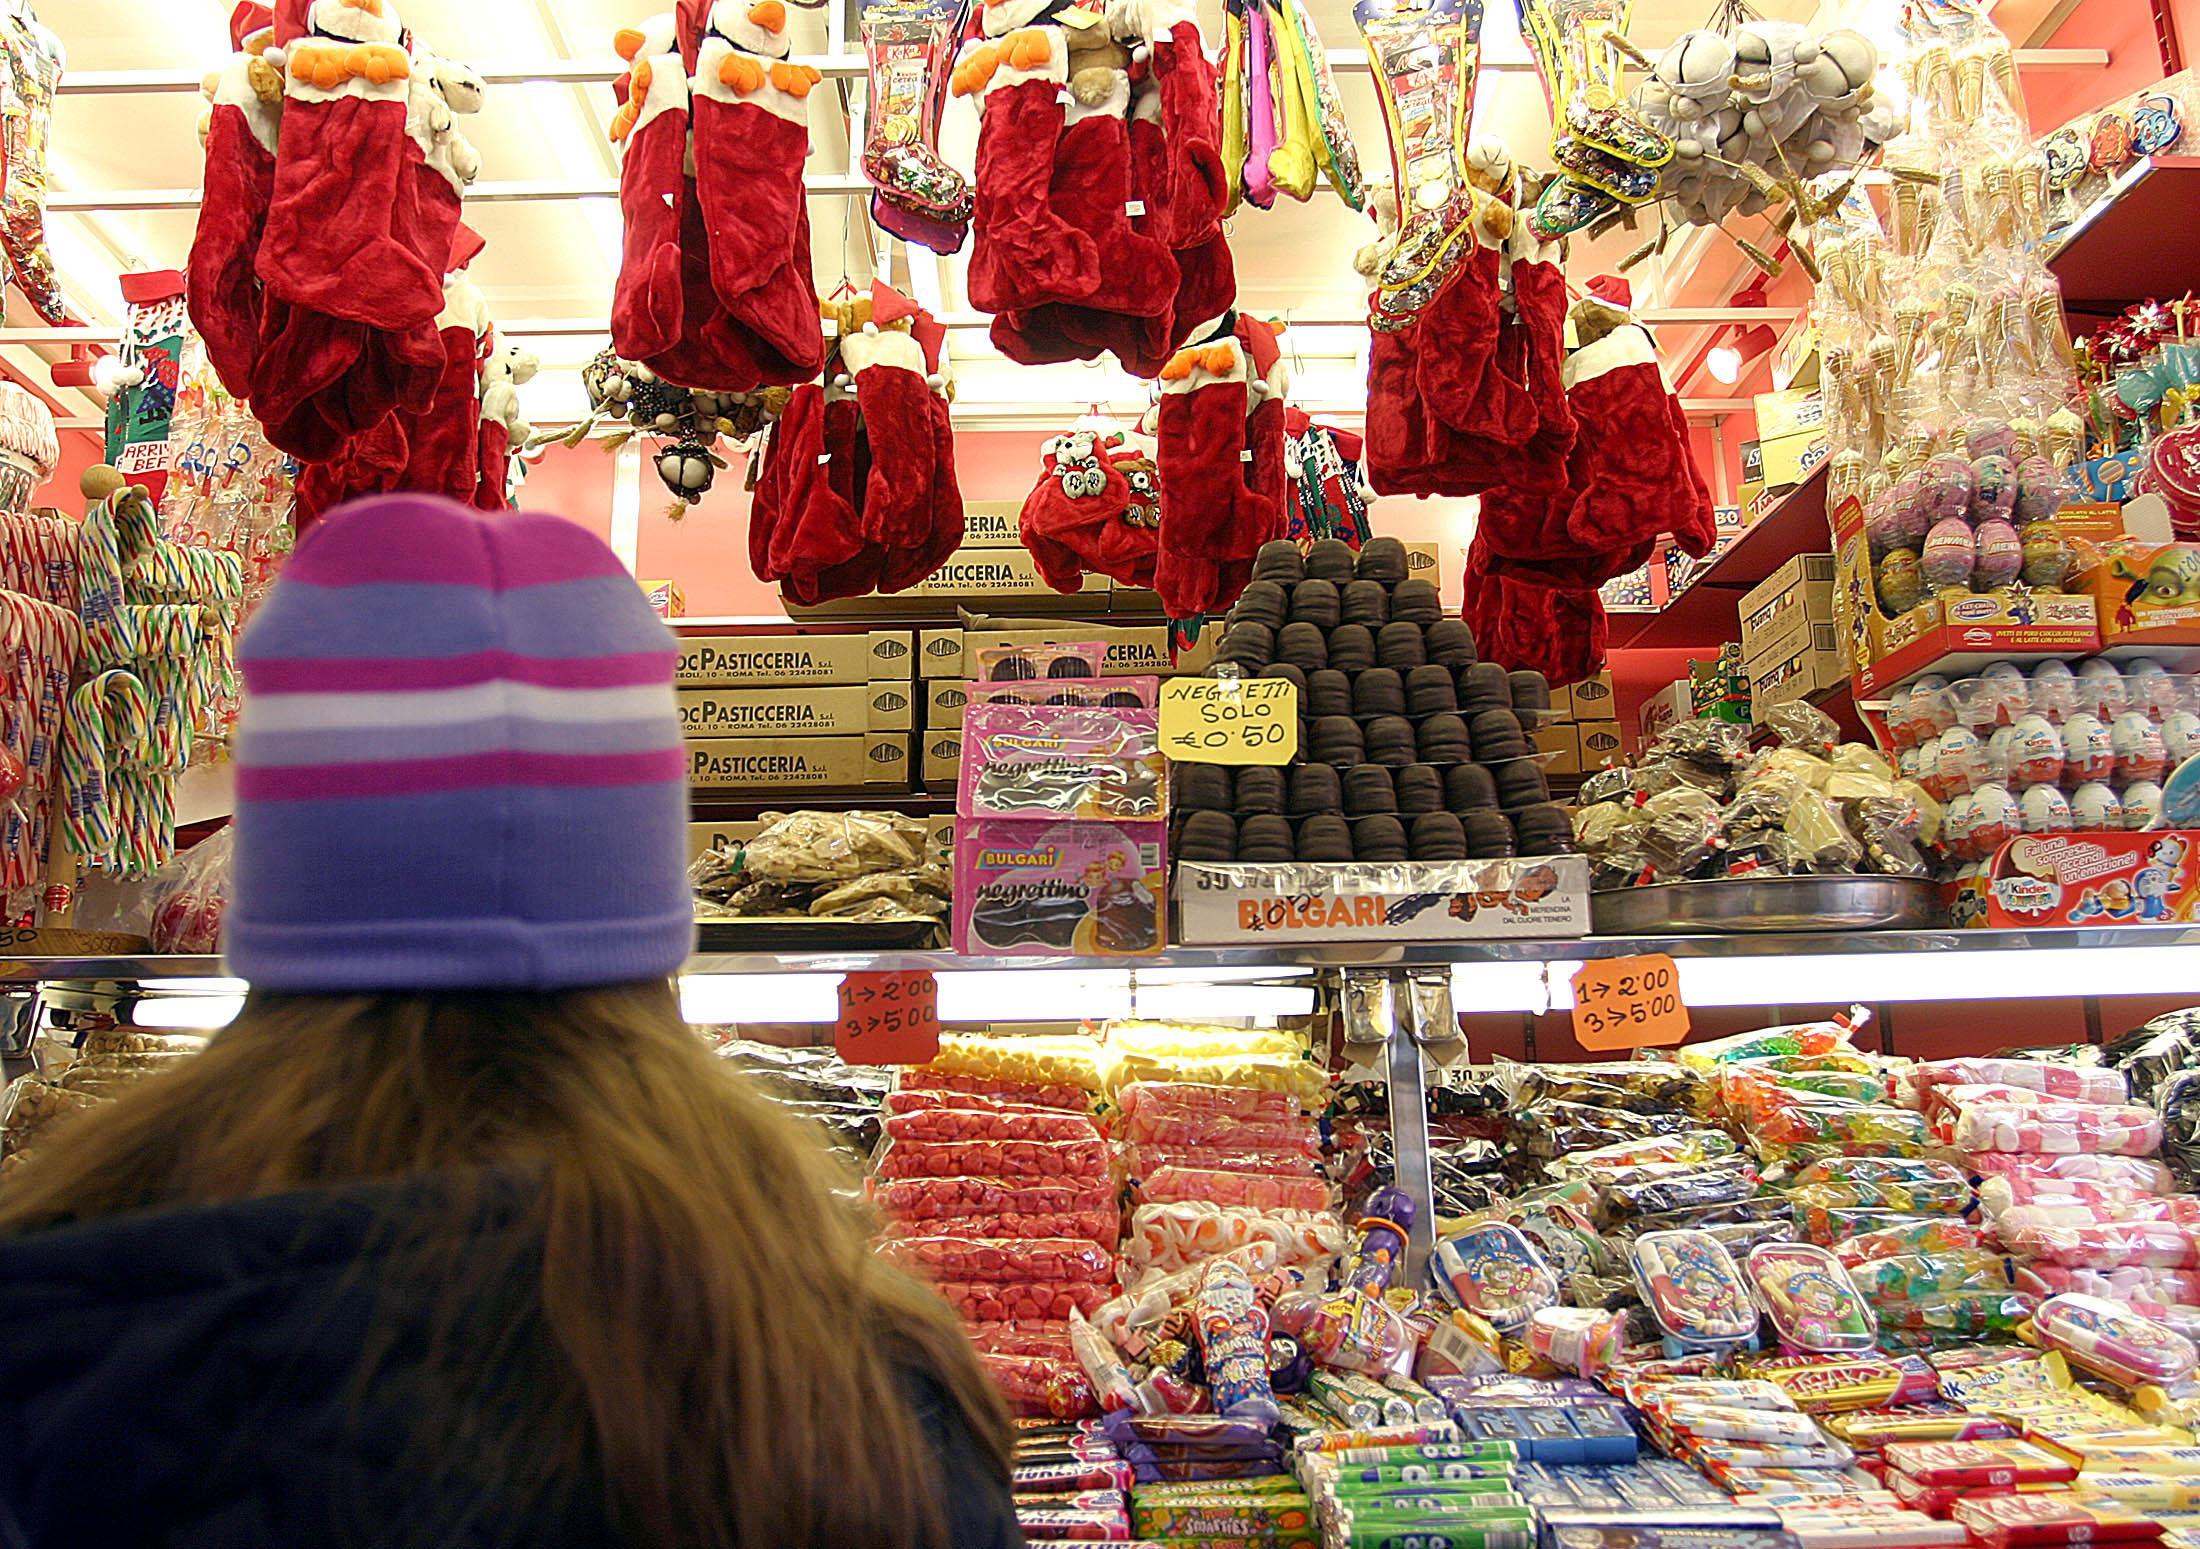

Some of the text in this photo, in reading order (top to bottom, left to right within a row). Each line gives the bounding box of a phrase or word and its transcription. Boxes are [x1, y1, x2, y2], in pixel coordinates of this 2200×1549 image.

[726, 670, 754, 678] ROMA
[1200, 703, 1271, 723] SOLO
[790, 721, 835, 729] 22428081
[783, 773, 828, 781] 22428081
[2025, 838, 2065, 857] Fai una
[2060, 848, 2104, 871] accendi
[1577, 982, 1591, 1004] 1
[847, 1019, 862, 1038] 3
[1584, 1012, 1605, 1033] 3
